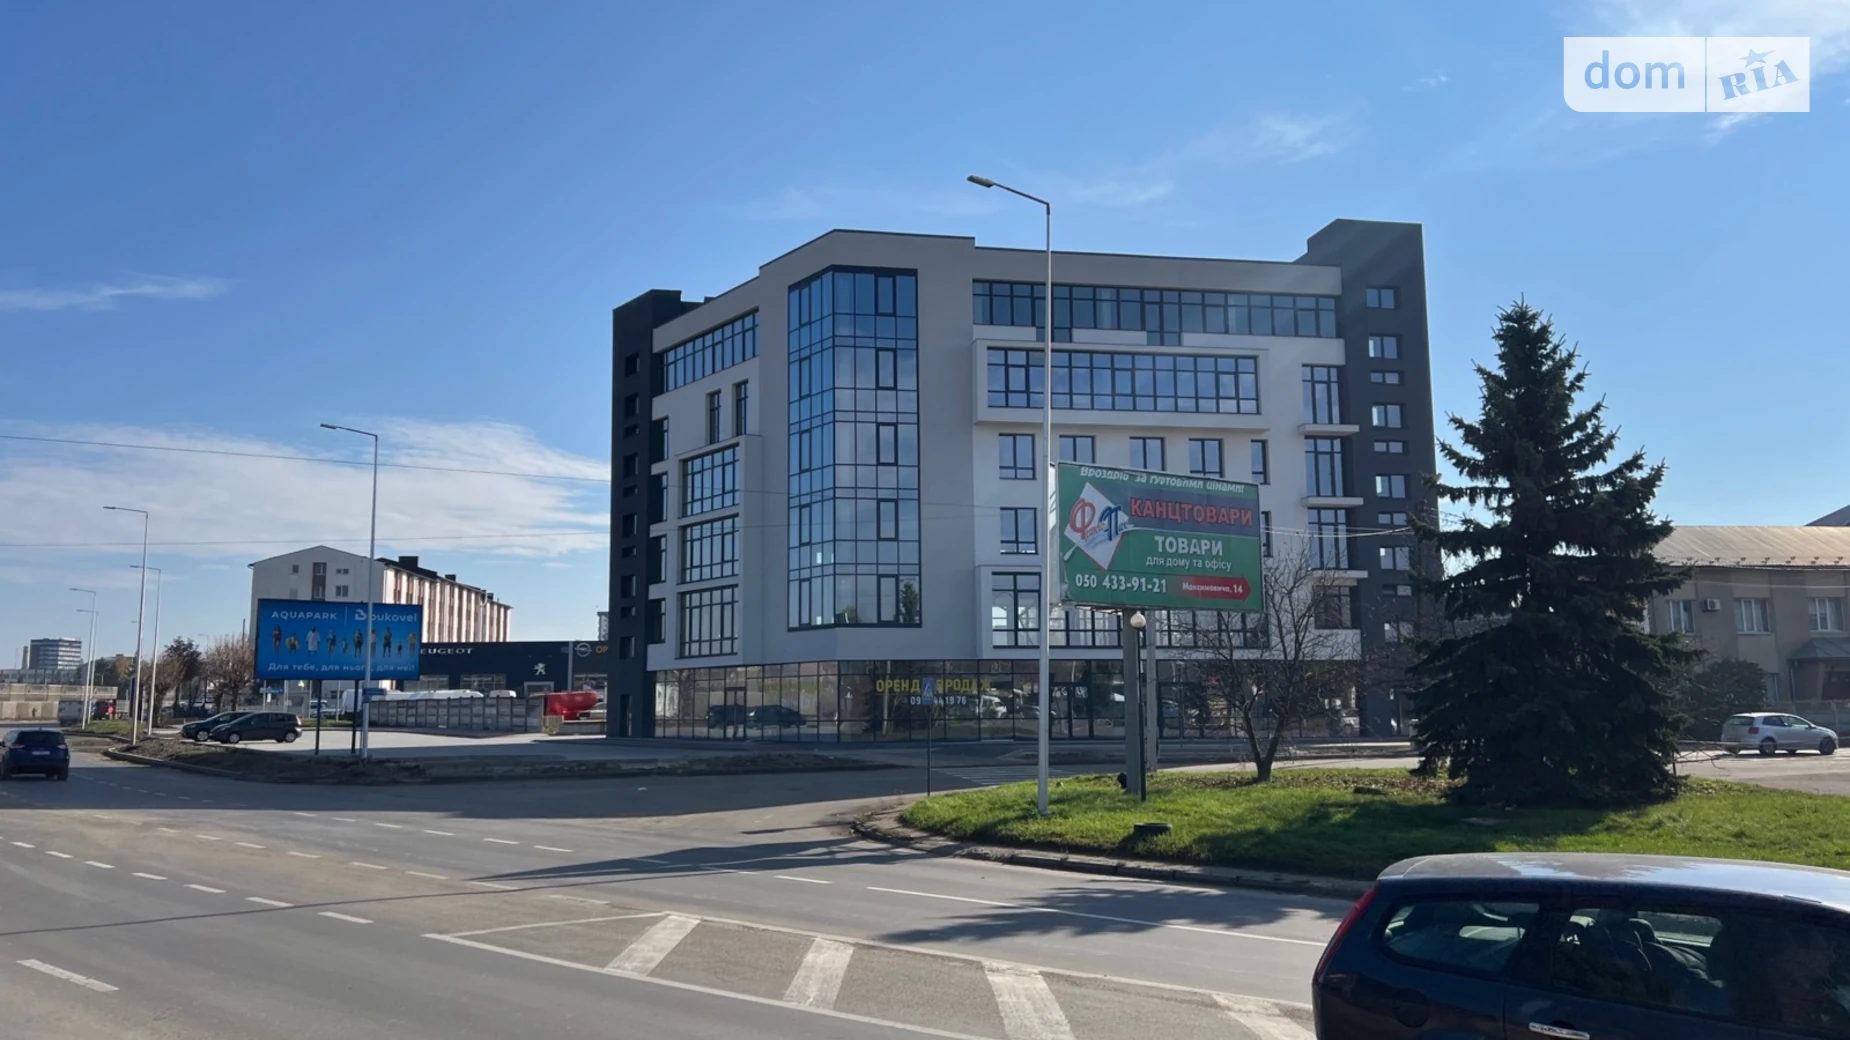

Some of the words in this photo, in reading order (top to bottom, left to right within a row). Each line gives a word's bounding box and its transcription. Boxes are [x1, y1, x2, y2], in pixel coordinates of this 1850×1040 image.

[1129, 496, 1253, 527] КАНЦТОВАРИ
[1154, 535, 1223, 556] ТОВАРИ
[1146, 556, 1165, 567] для
[1166, 558, 1190, 570] дому
[1192, 559, 1203, 568] та
[1204, 559, 1232, 572] офісу
[1075, 573, 1097, 588] 050
[1102, 575, 1167, 593] 433-91-21
[1233, 584, 1243, 594] 14
[271, 610, 337, 620] AQUAPARK
[595, 645, 609, 654] OP
[268, 662, 289, 671] Для
[321, 664, 340, 672] для
[876, 679, 922, 693] ОРЕНД
